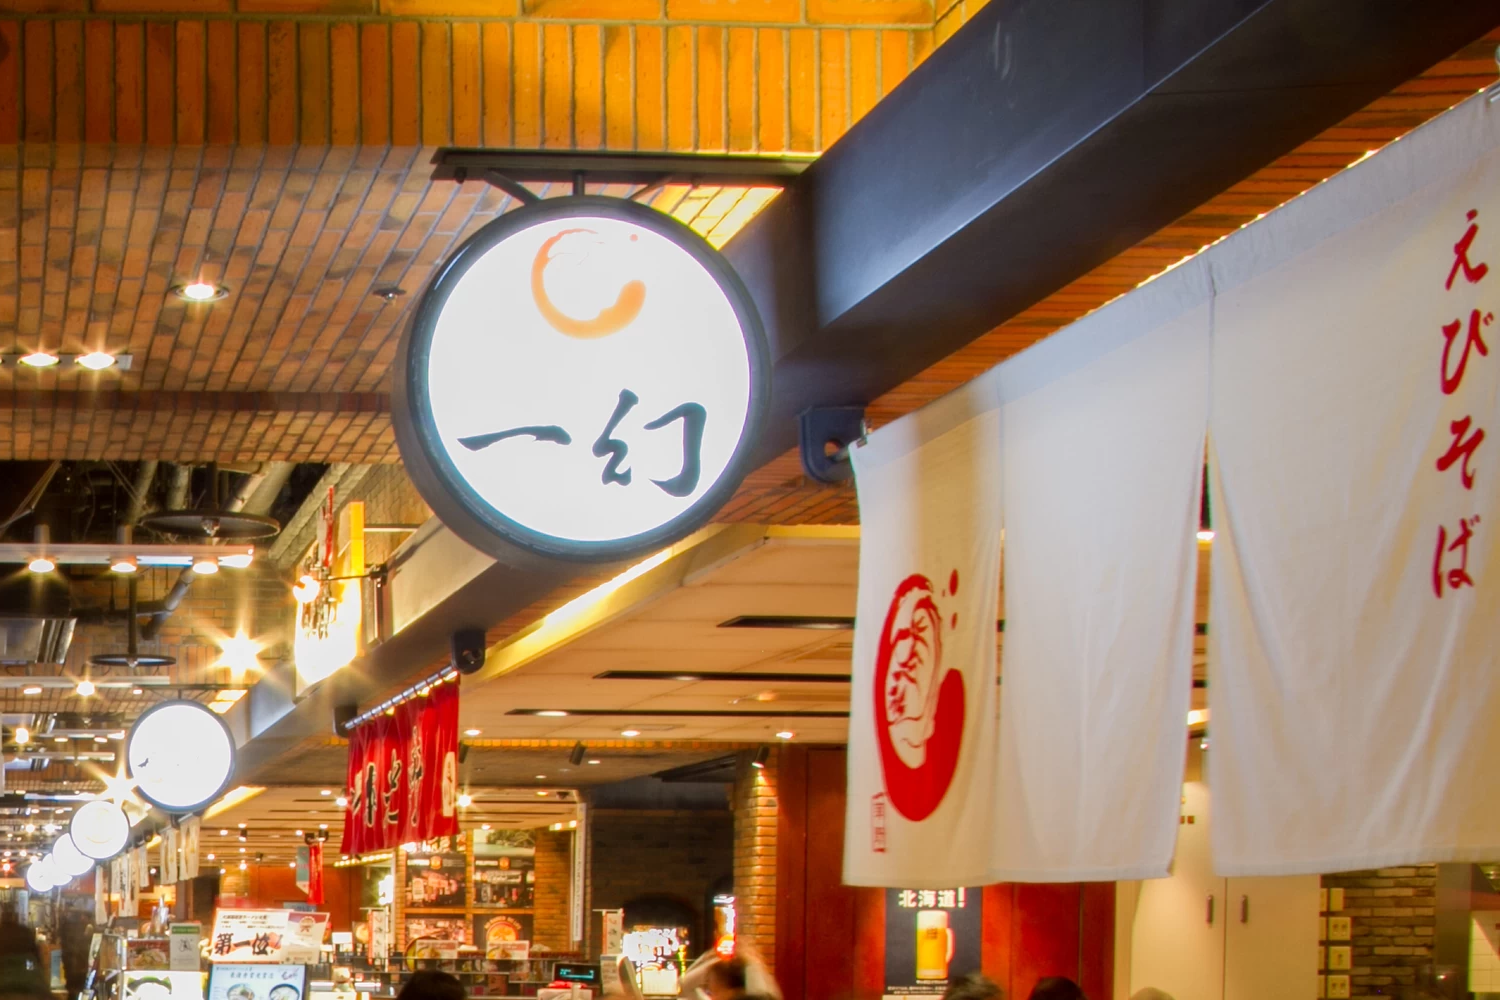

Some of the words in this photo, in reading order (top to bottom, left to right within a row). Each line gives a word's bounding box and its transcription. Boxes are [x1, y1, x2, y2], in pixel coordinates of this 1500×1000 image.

[457, 388, 708, 499] 一幻
[1431, 208, 1494, 600] えびそば
